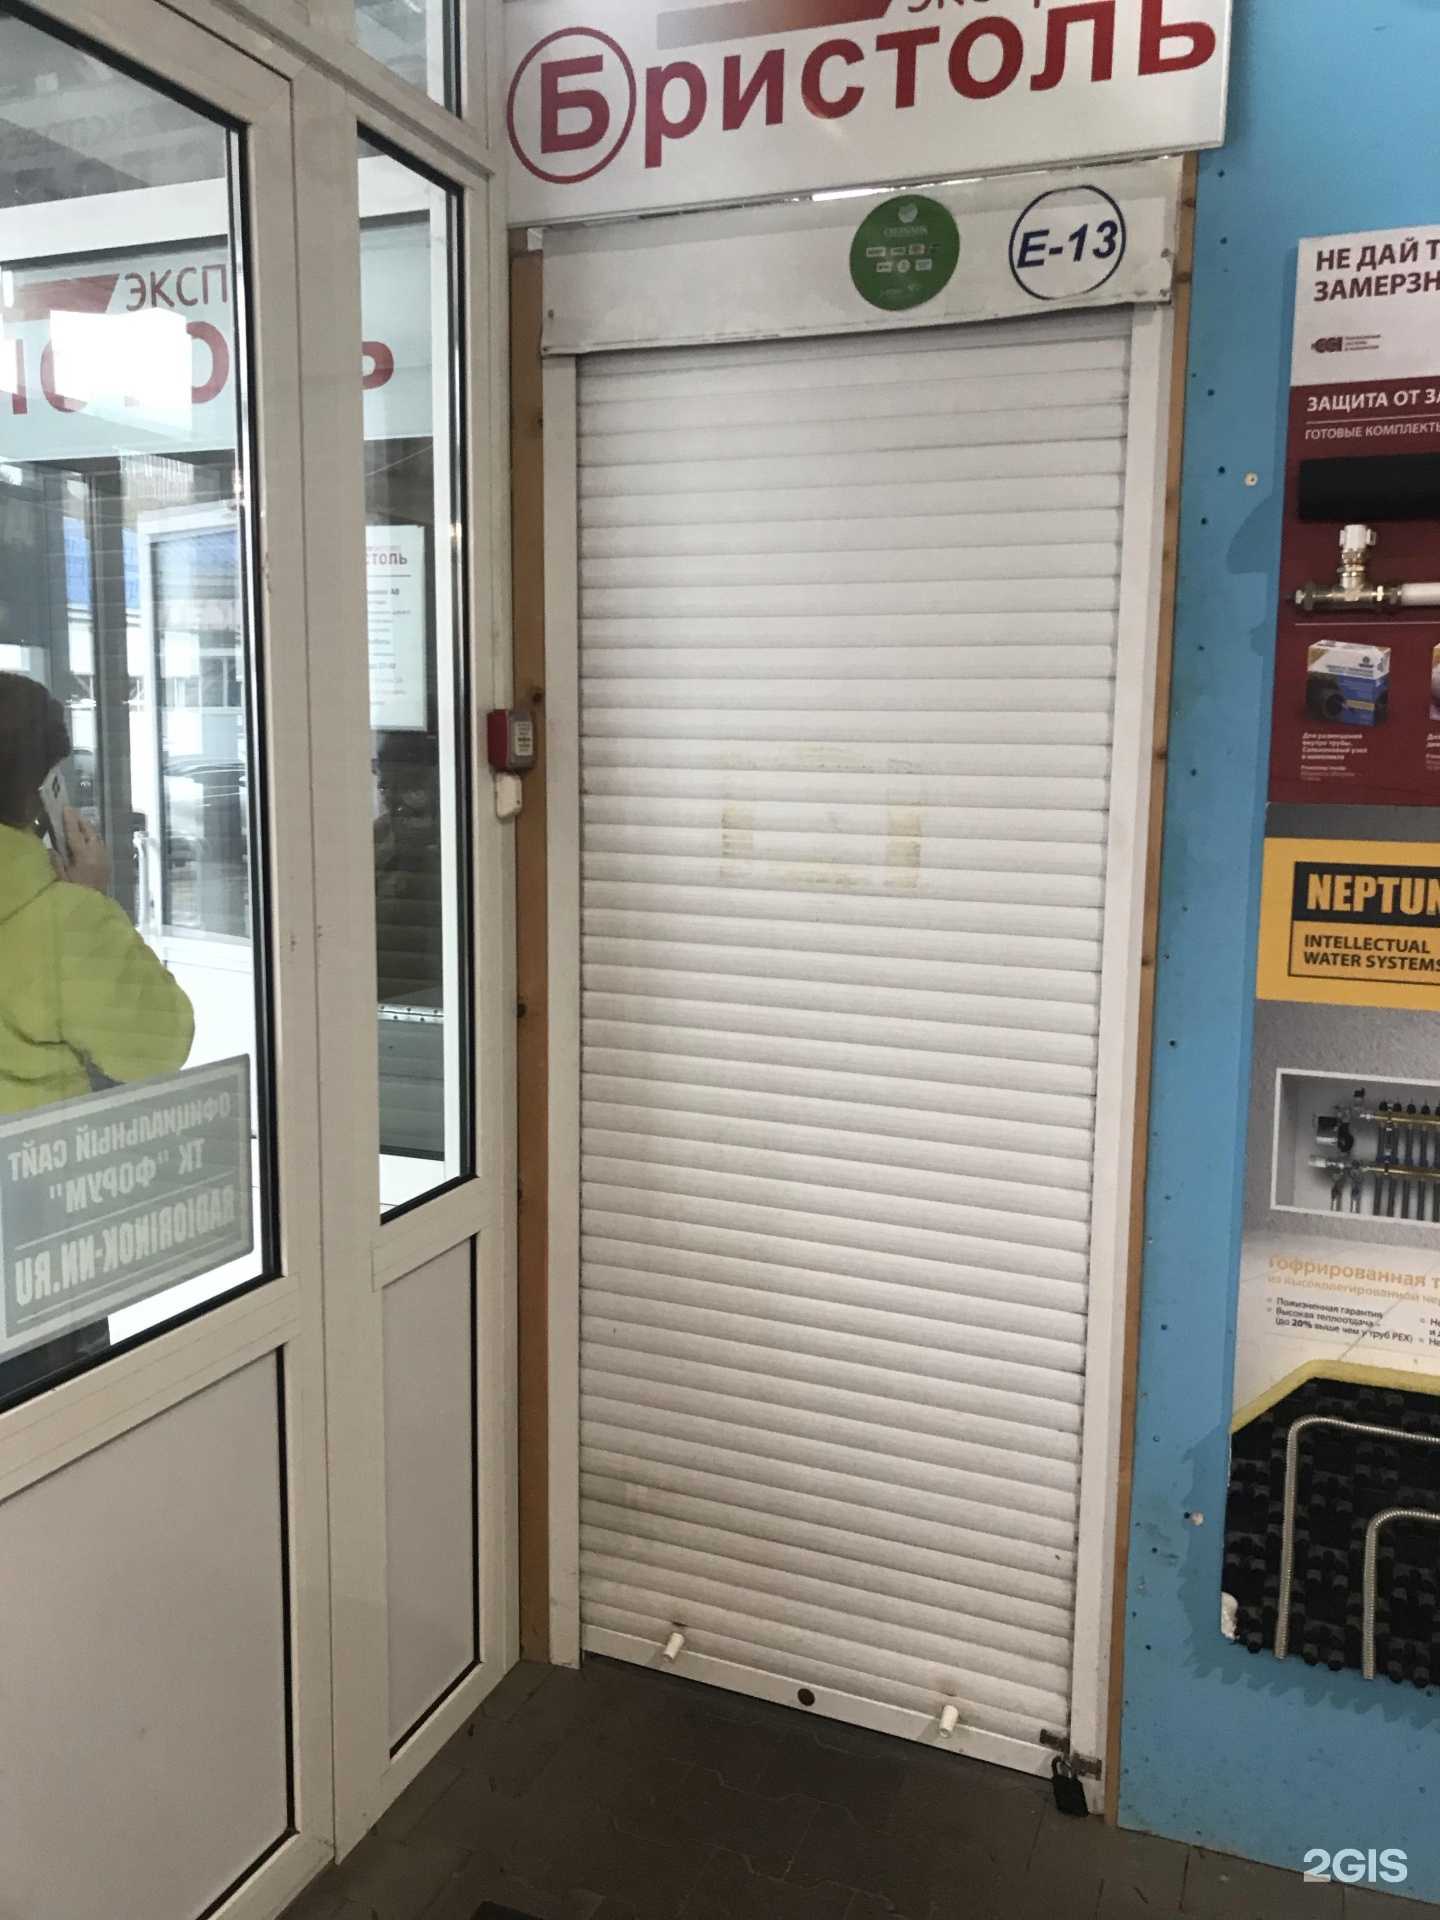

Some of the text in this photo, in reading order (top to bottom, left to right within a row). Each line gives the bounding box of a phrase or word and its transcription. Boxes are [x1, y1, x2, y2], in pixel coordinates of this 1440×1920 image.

[541, 0, 1217, 169] Бристоль
[1316, 248, 1351, 272] НЕ
[1356, 236, 1418, 272] ДАЙ
[1306, 391, 1389, 413] ЗАЩИТА
[1393, 389, 1421, 406] ОТ
[1305, 426, 1363, 440] ГОТОВЫЕ
[1304, 934, 1431, 954] INTELLECTUAL
[1304, 951, 1361, 968] WATER
